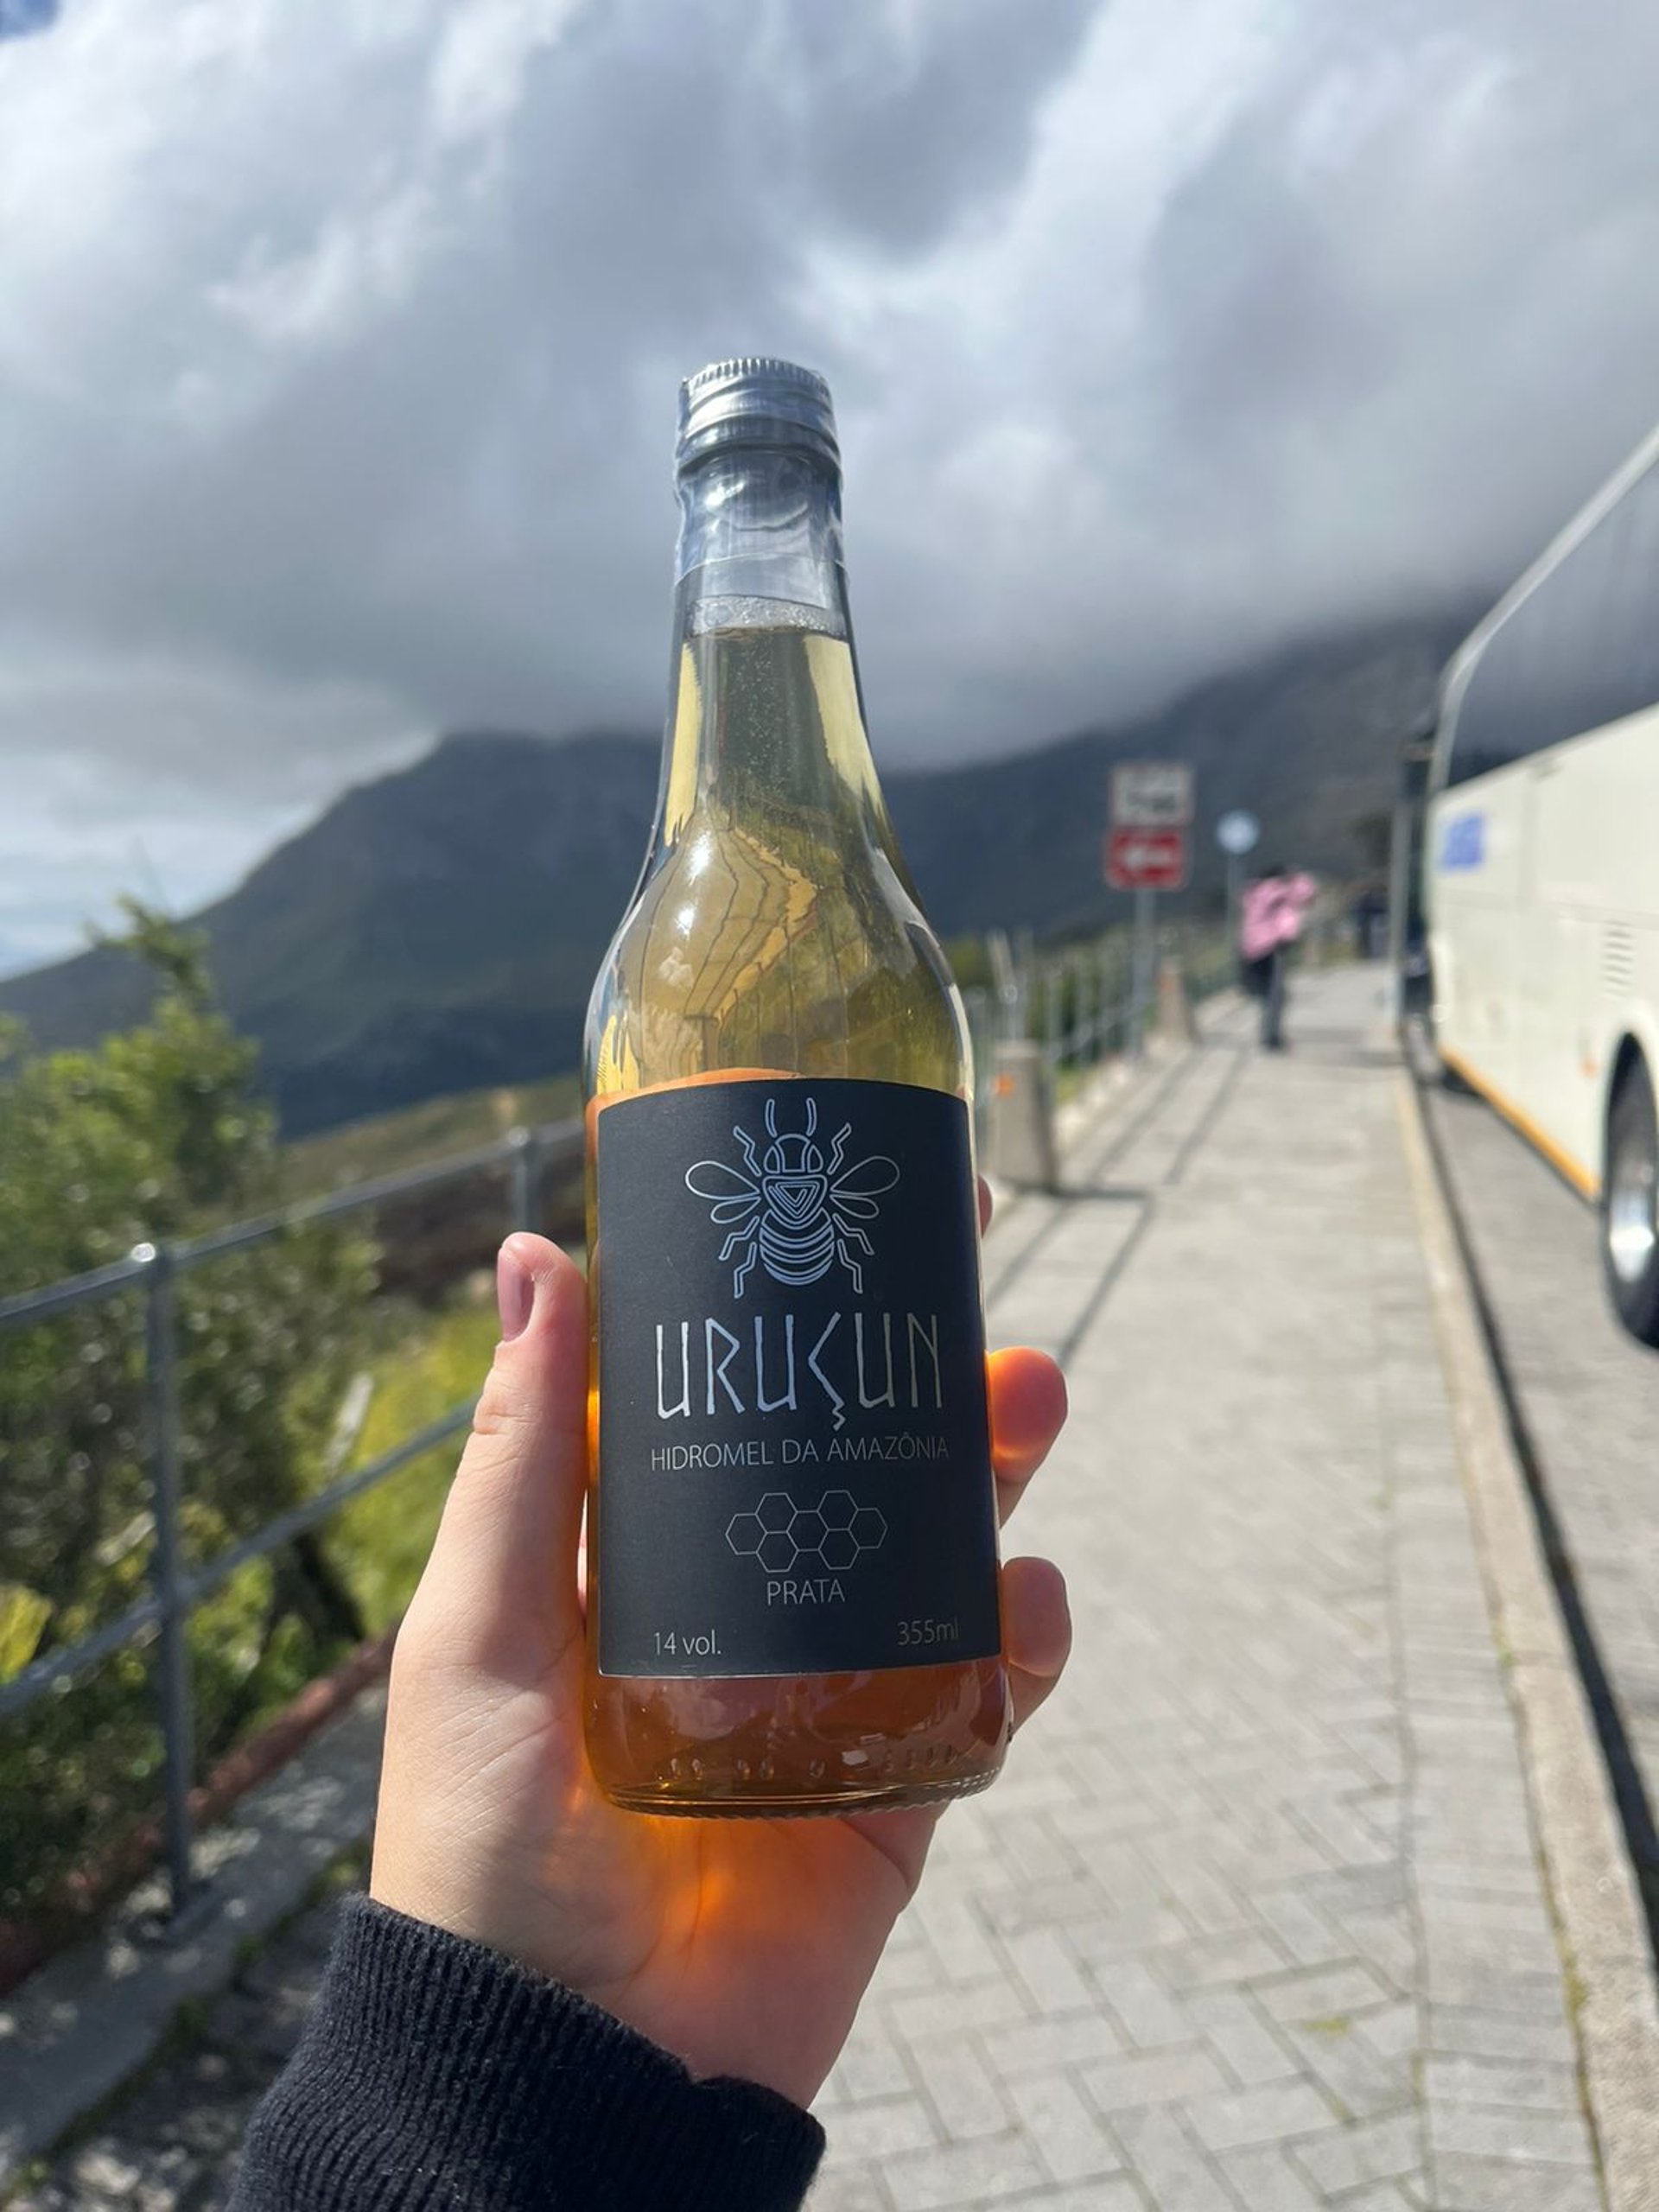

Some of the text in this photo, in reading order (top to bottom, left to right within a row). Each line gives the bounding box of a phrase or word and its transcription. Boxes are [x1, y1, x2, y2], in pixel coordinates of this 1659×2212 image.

[655, 1312, 943, 1430] URUÇUN
[652, 1432, 949, 1471] HIDROMEL DA AMAZÔNIA
[766, 1579, 846, 1605] PRATA
[654, 1629, 721, 1656] 14 vol.
[896, 1617, 959, 1646] 355ml
